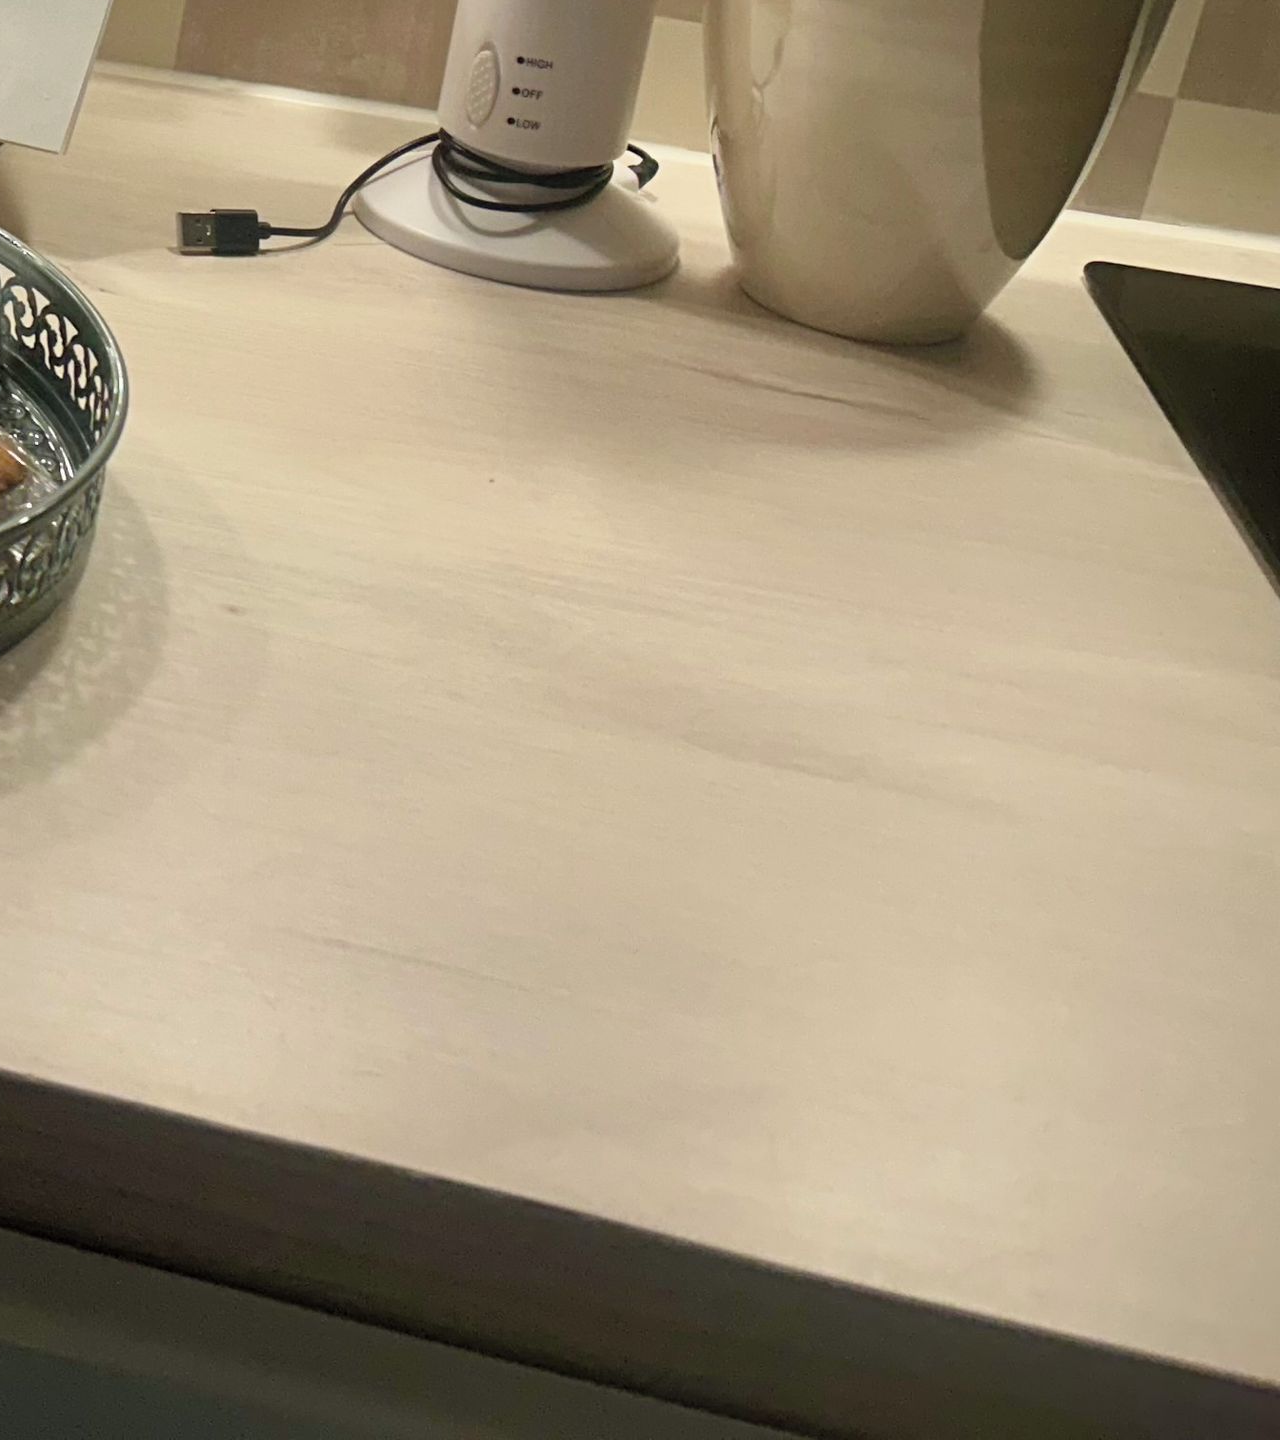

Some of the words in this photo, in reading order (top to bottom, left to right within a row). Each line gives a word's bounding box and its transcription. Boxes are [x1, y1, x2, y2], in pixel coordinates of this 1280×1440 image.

[526, 58, 553, 69] HIGH
[521, 88, 544, 100] OFF
[516, 119, 541, 131] LOW
